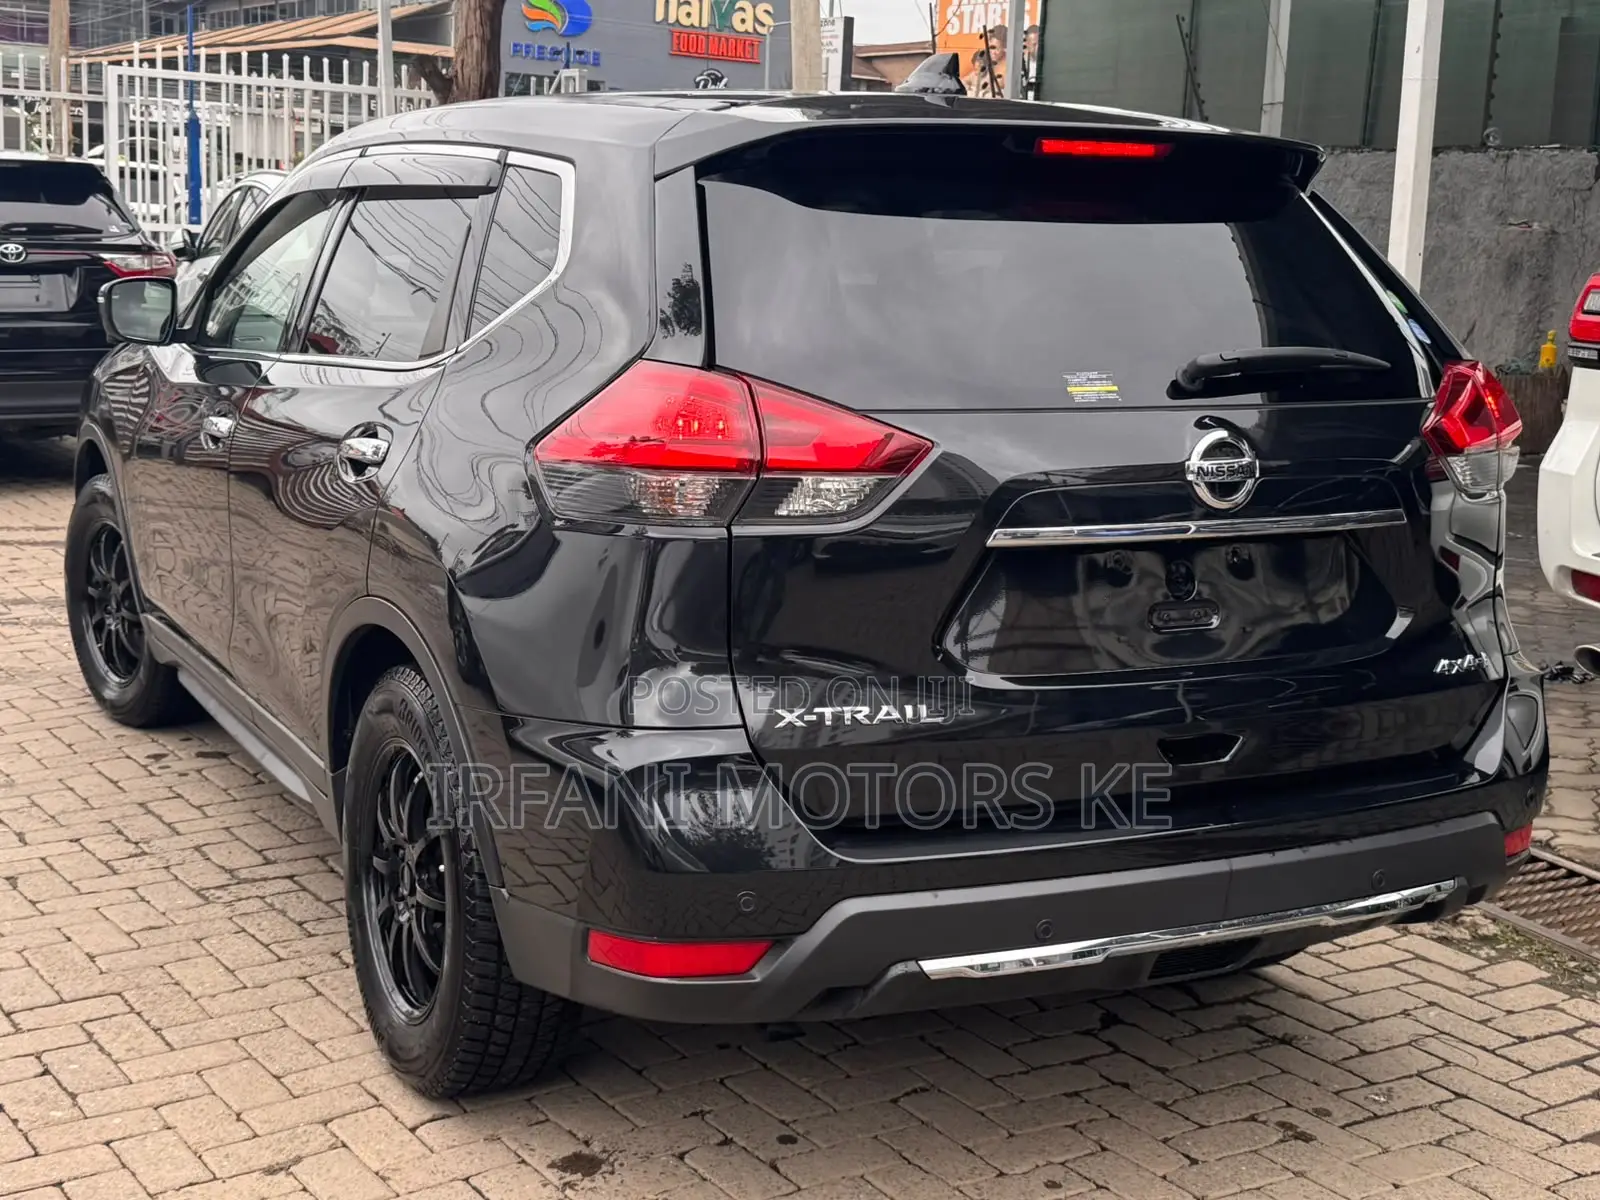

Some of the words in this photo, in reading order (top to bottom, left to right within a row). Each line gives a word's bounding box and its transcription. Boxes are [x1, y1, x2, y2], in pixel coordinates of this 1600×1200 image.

[672, 32, 706, 55] FOOD
[708, 36, 761, 60] MARKET
[1196, 462, 1254, 477] NISSAN
[774, 704, 946, 728] X-TRAIL
